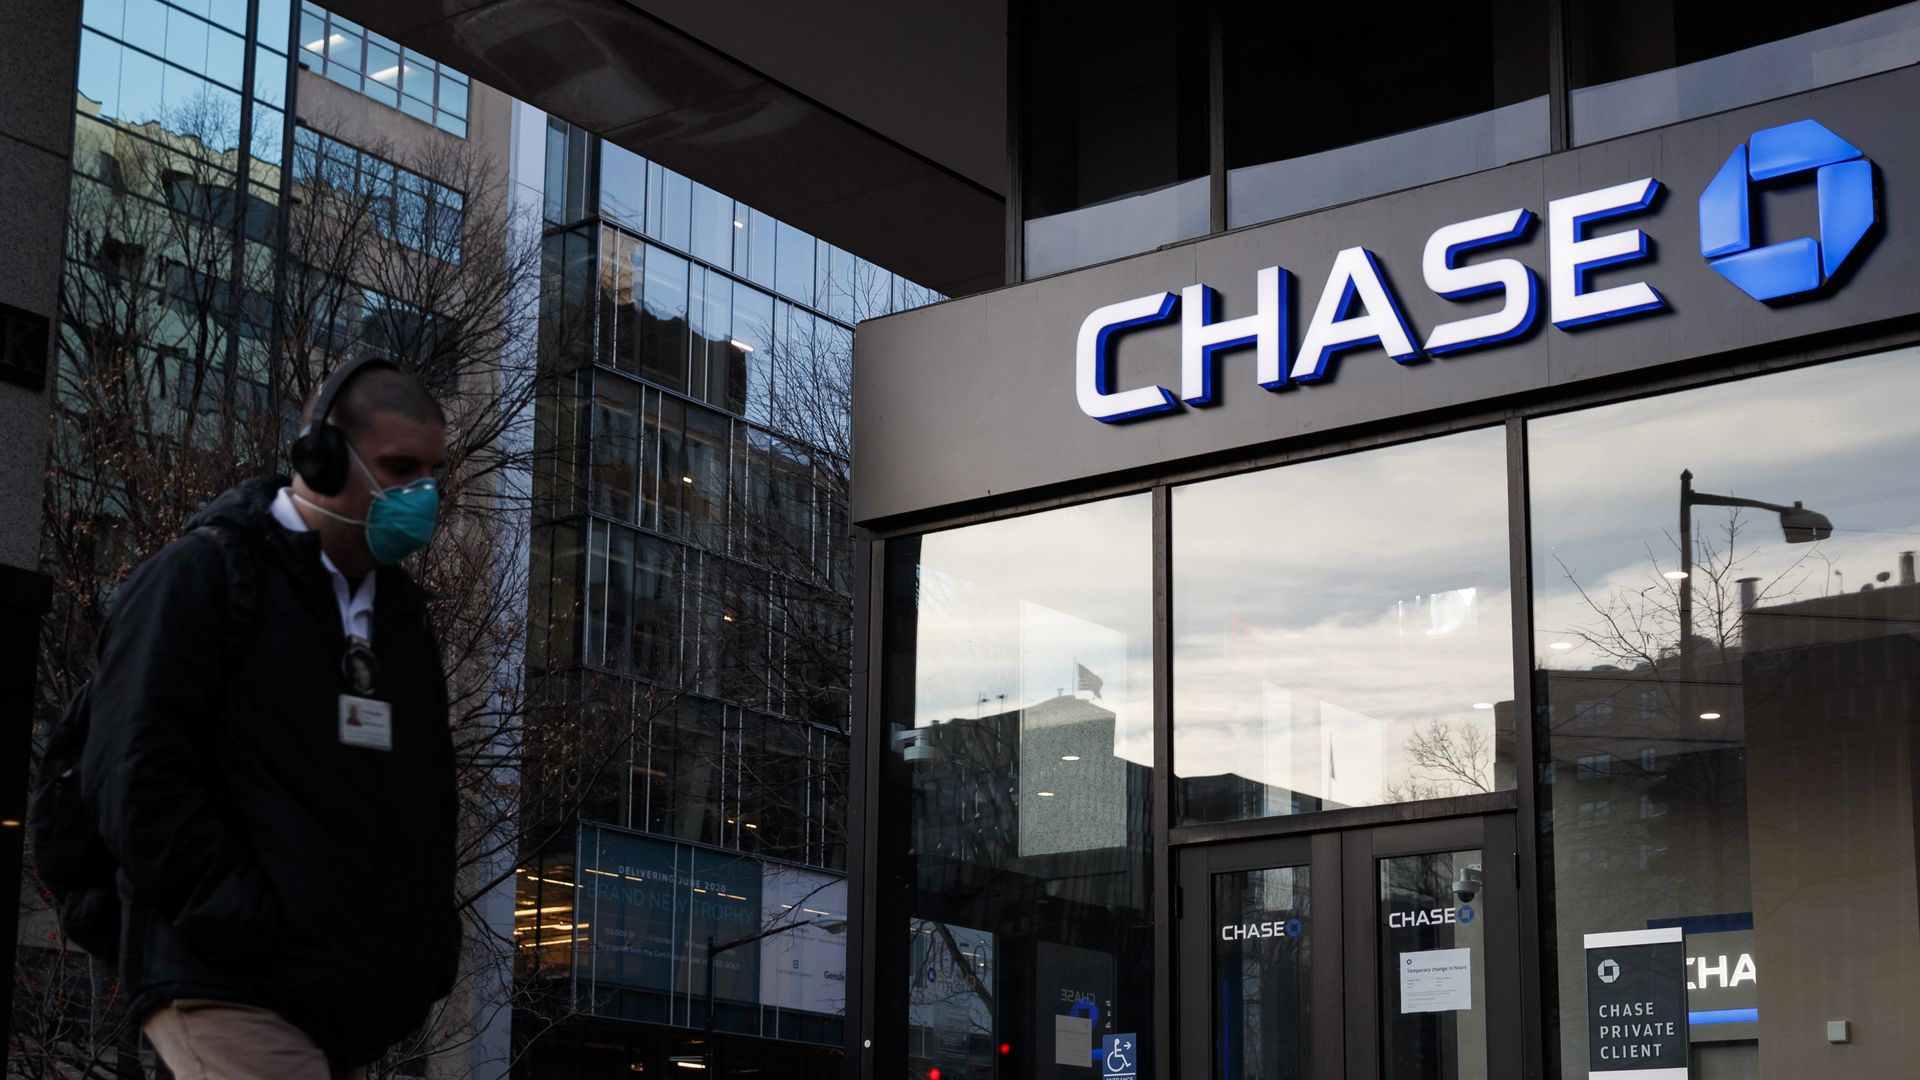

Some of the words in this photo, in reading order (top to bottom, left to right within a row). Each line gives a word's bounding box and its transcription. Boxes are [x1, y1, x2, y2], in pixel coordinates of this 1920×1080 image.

[1075, 176, 1671, 425] CHASE
[618, 865, 674, 884] DELIVERING
[678, 876, 700, 888] JUE
[704, 881, 727, 892] 2020
[586, 880, 644, 907] BRAND
[650, 894, 687, 913] NEW
[693, 900, 754, 924] TROPHY
[1388, 907, 1457, 929] CHASE
[1221, 920, 1285, 941] CHASE
[1599, 1002, 1655, 1018] CHASE
[1600, 1022, 1675, 1039] PRIVATE
[1600, 1043, 1662, 1060] CLIENT
